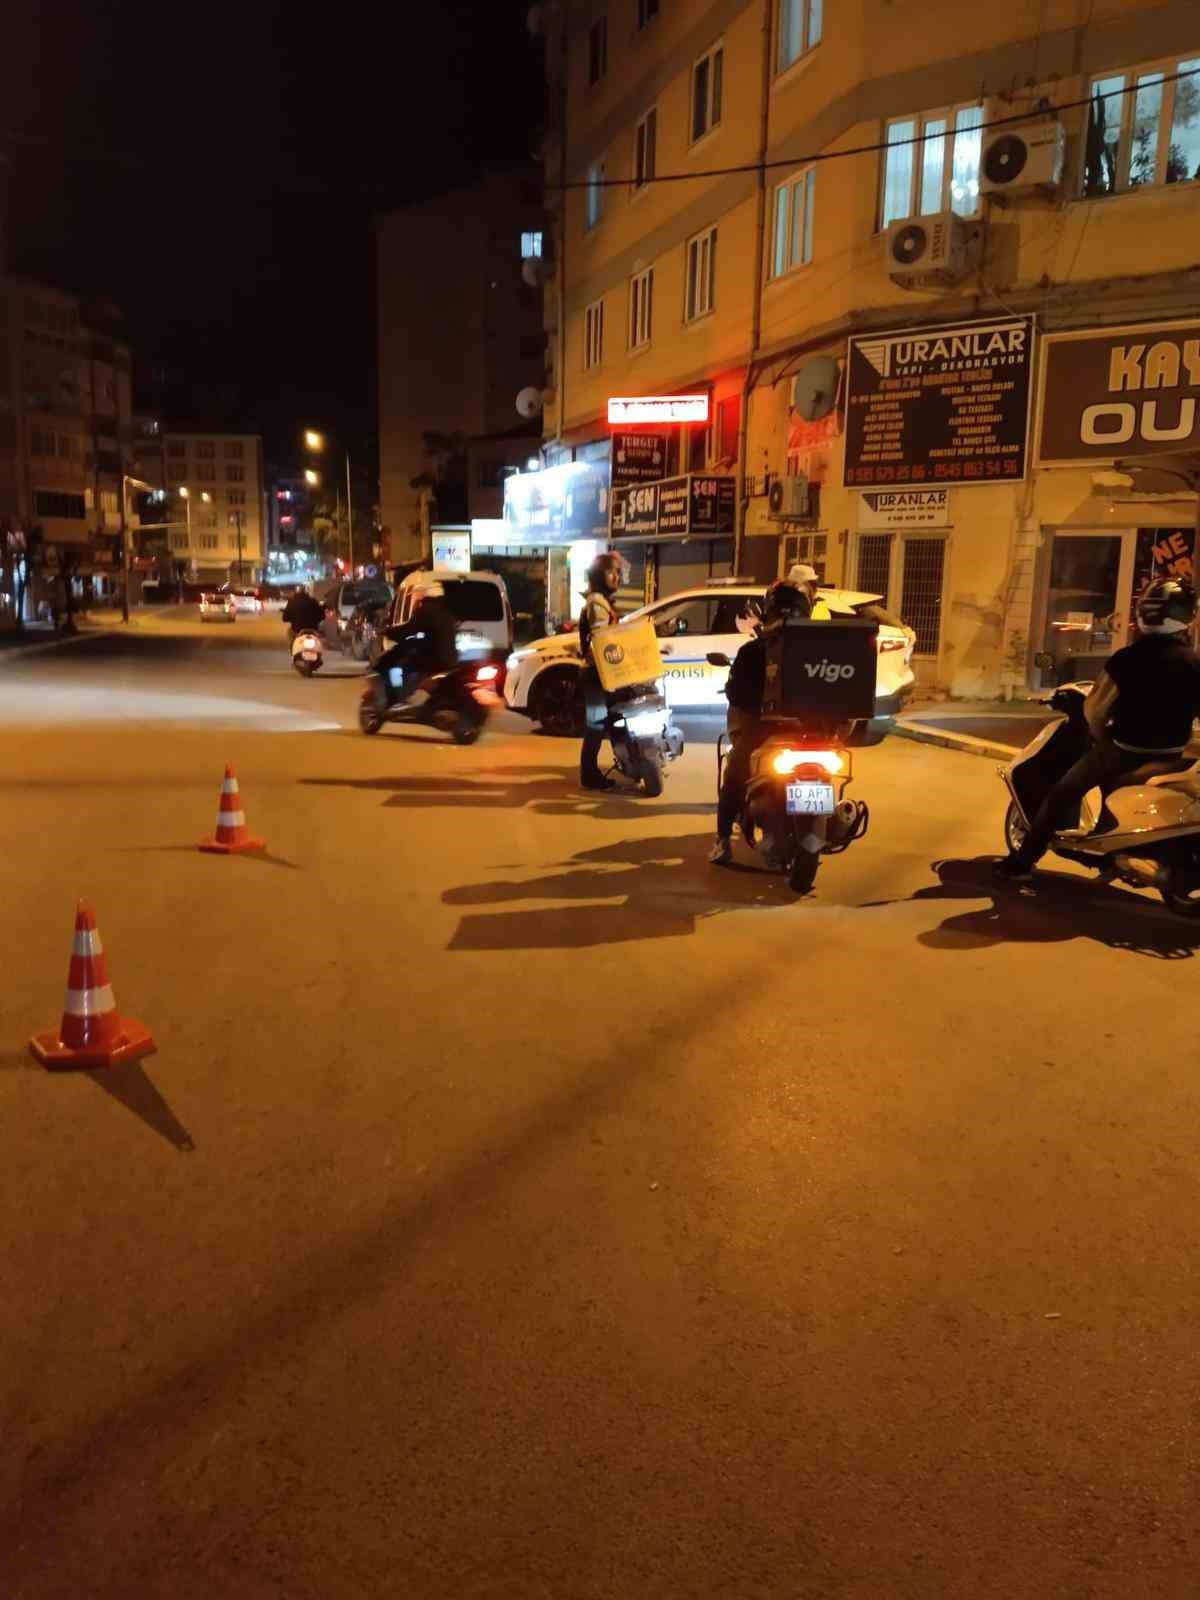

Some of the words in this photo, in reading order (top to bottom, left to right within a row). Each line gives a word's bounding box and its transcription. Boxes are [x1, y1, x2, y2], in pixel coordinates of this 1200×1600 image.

[896, 365, 922, 376] YAPI
[941, 354, 1024, 371] DEKORASYON
[805, 659, 855, 682] vigo
[789, 788, 802, 799] 10
